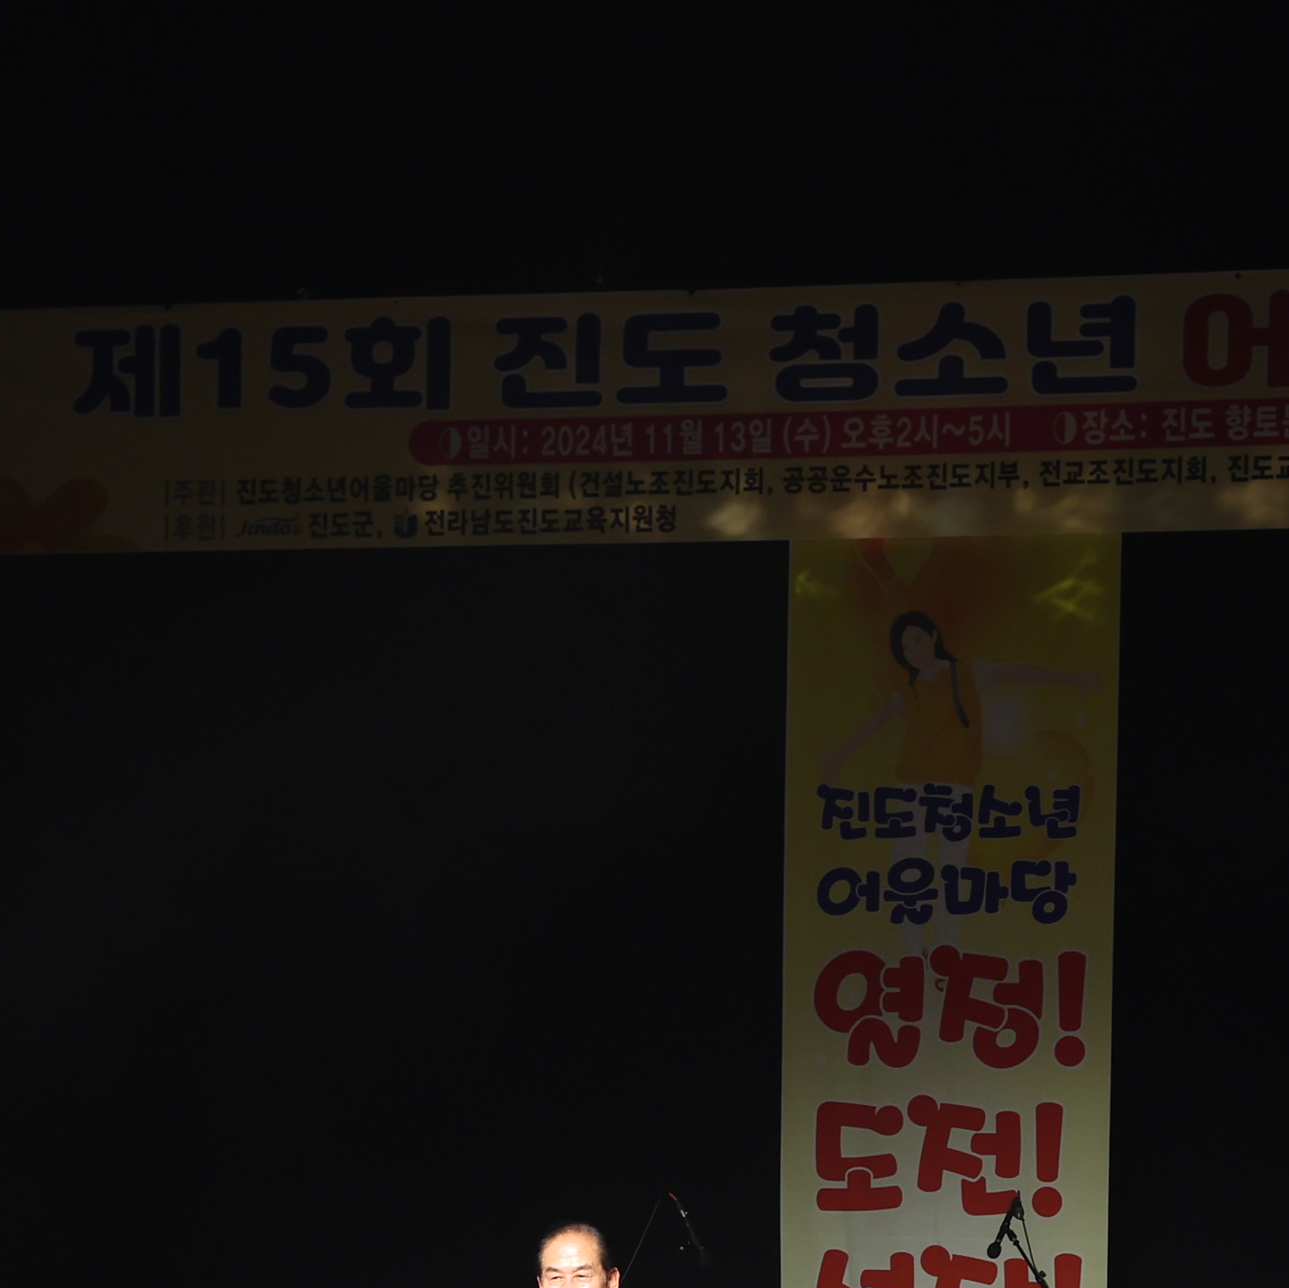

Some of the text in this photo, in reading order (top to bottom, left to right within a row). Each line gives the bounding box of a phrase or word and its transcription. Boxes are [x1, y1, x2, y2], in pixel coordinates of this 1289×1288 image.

[73, 316, 451, 418] 제15회
[495, 312, 727, 407] 진도
[770, 295, 1138, 402] 청소년
[467, 425, 529, 459] 일시:
[541, 421, 634, 457] 2024년
[646, 418, 703, 455] 11월
[714, 418, 772, 453] 13일
[782, 414, 832, 454] (수)
[841, 411, 1011, 449] 오후2시~5시
[1082, 409, 1147, 444] 장소:
[1162, 406, 1215, 441] 진도
[236, 473, 440, 505] 진도청소년어울마당
[447, 471, 560, 500] 추진위원회
[568, 466, 774, 499] (건설노조진도지회,
[783, 461, 1029, 494] 공공운수노조진도지부,
[1040, 455, 1217, 487] 전교조진도지회,
[308, 511, 383, 539] 진도군,
[424, 505, 677, 536] 전라남도진도교육지원청
[817, 783, 1080, 841] 진도청소년
[817, 857, 1077, 924] 어울마당
[814, 945, 1086, 1069] 열정!
[816, 1094, 1063, 1217] 도전!
